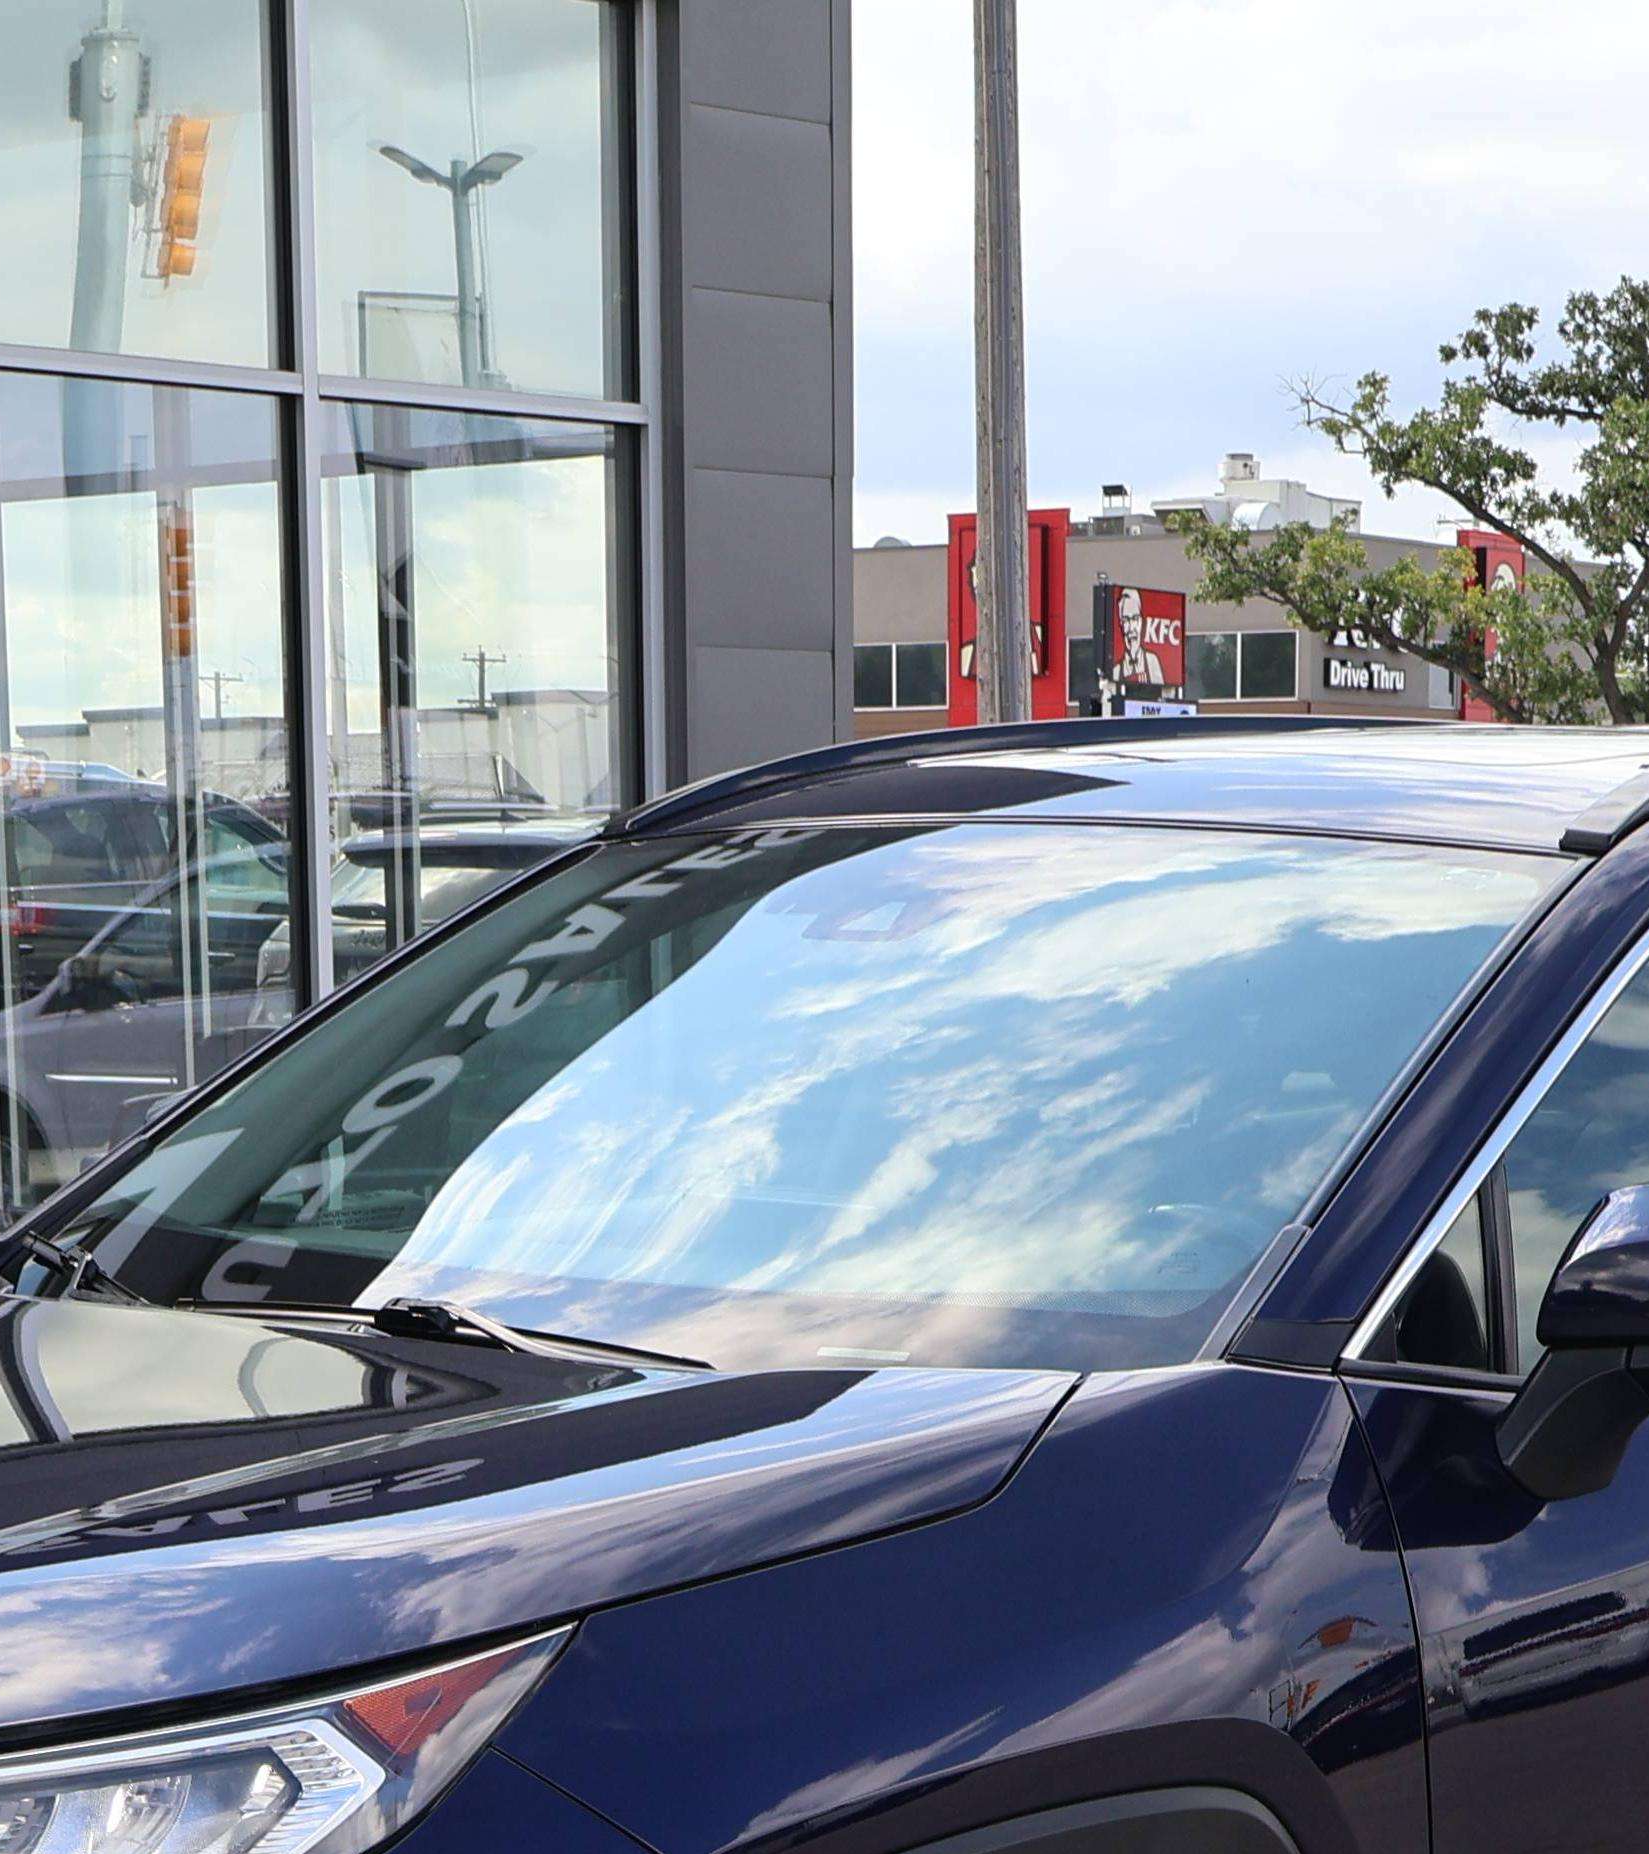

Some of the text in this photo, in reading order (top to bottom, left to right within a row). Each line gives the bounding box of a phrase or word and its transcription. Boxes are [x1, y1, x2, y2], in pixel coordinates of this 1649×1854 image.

[1144, 616, 1182, 647] KFC
[1330, 659, 1405, 691] Drive Thru
